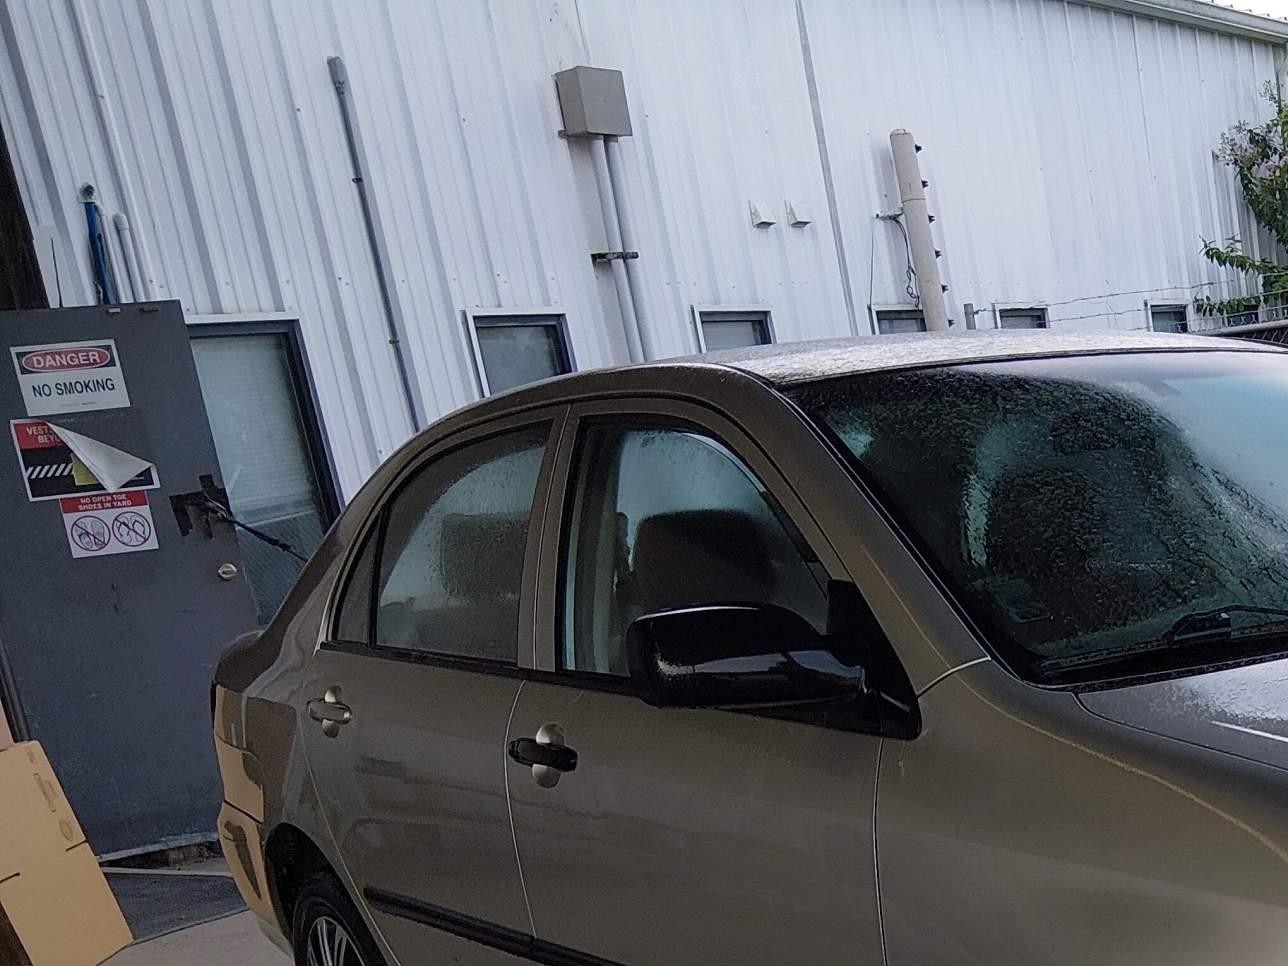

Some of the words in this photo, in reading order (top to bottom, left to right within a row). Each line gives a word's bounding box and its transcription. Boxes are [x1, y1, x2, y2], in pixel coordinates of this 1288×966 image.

[32, 351, 100, 368] DANGER
[32, 383, 52, 398] NO
[55, 378, 115, 396] SMOKING
[26, 425, 52, 435] VEST
